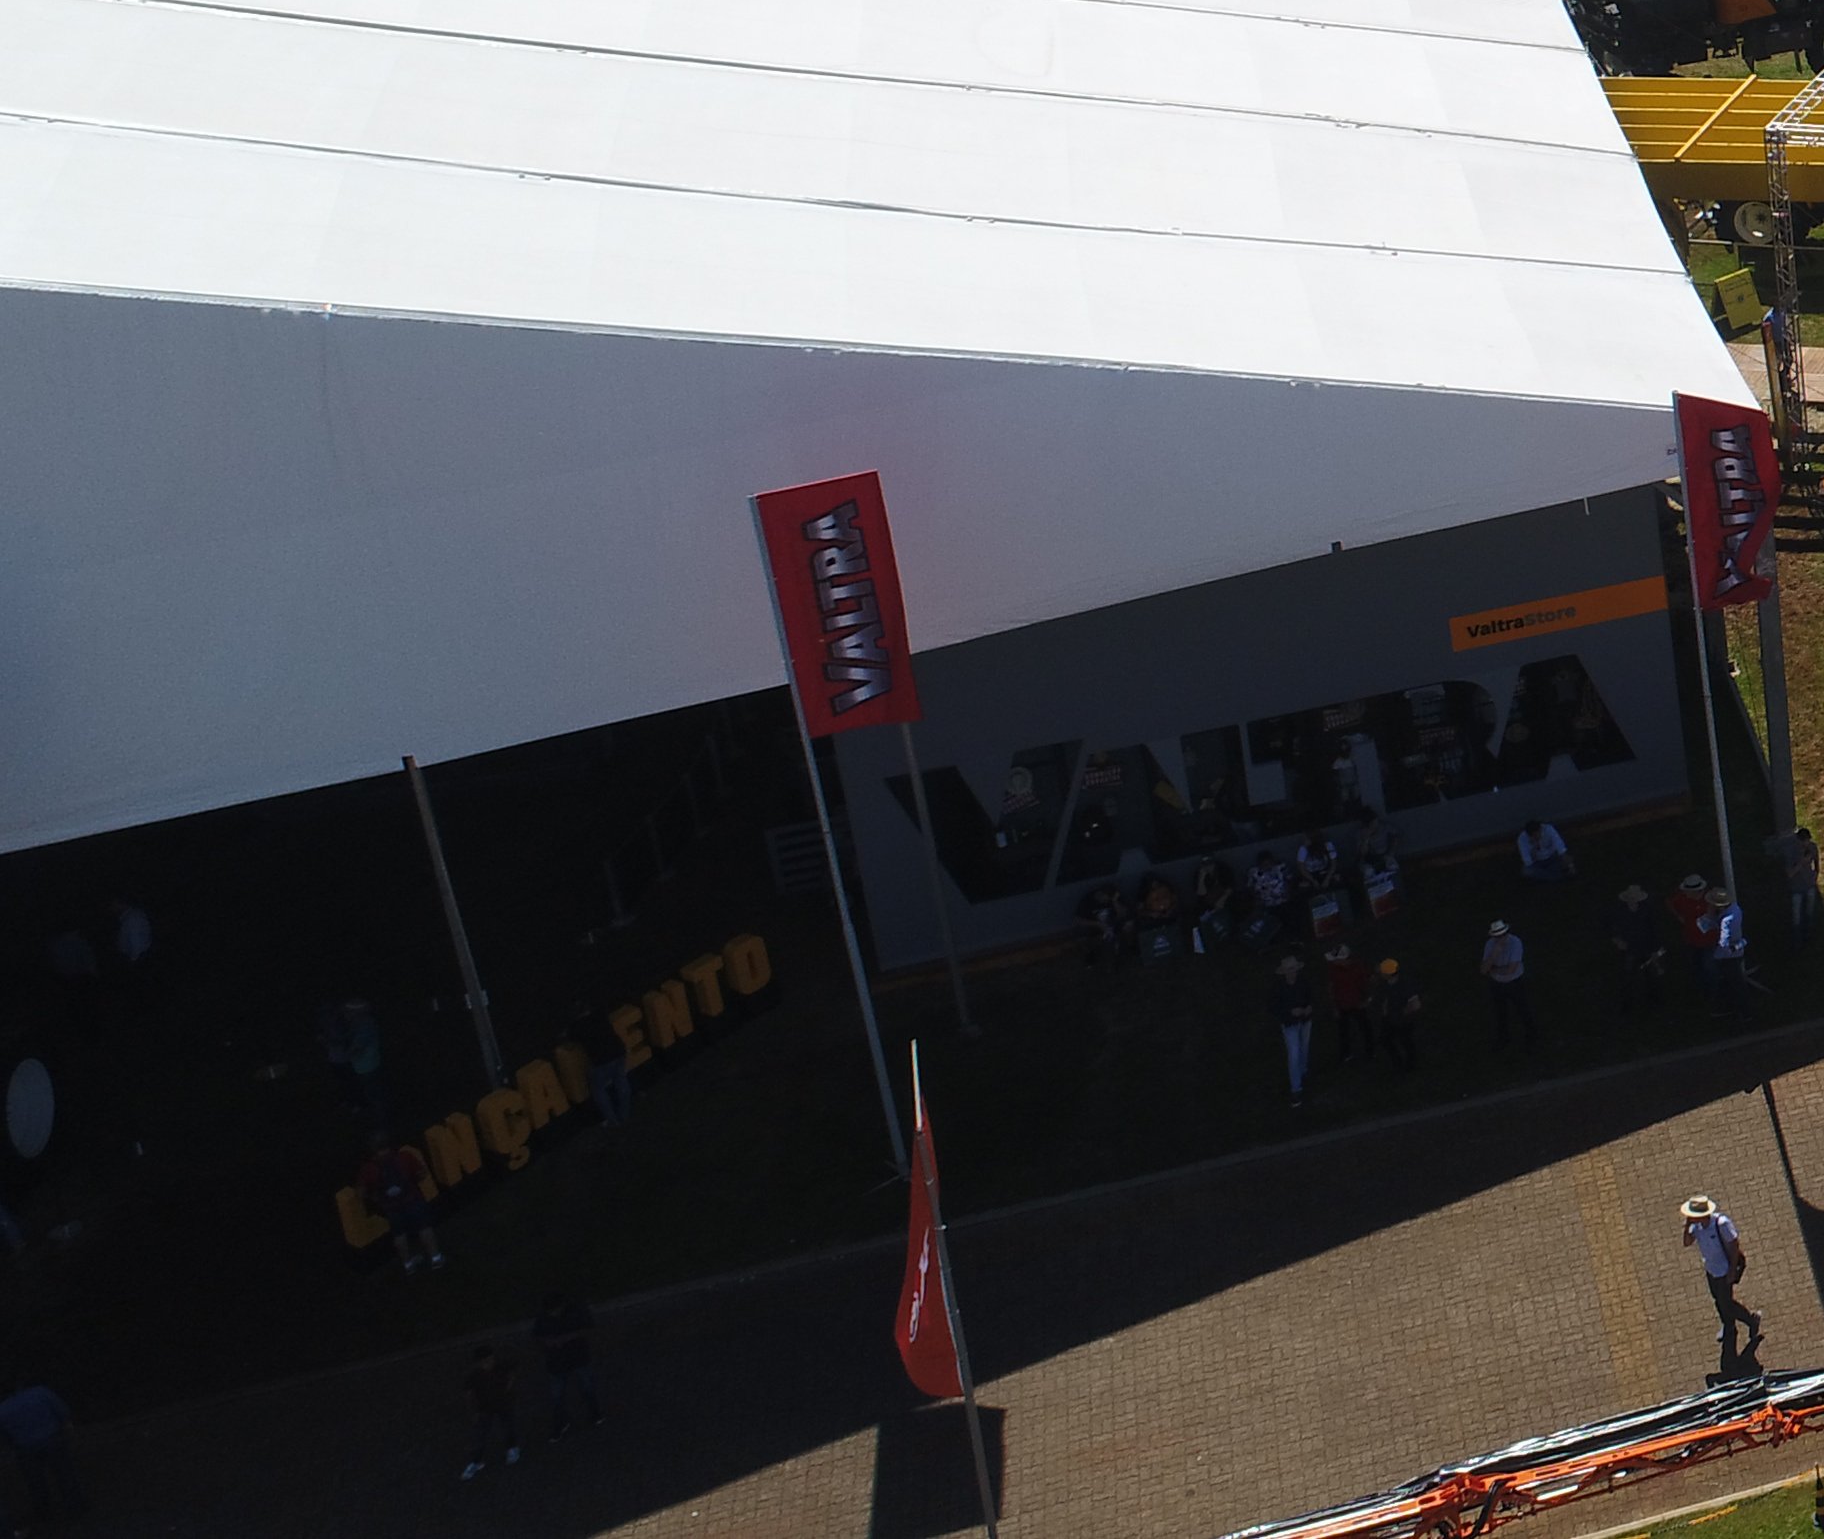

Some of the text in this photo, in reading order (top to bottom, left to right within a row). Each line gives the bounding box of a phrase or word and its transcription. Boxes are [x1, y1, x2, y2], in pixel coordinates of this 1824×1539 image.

[801, 499, 893, 717] VALTRA
[1466, 604, 1577, 639] ValtraStore
[886, 654, 1635, 904] VALTRA
